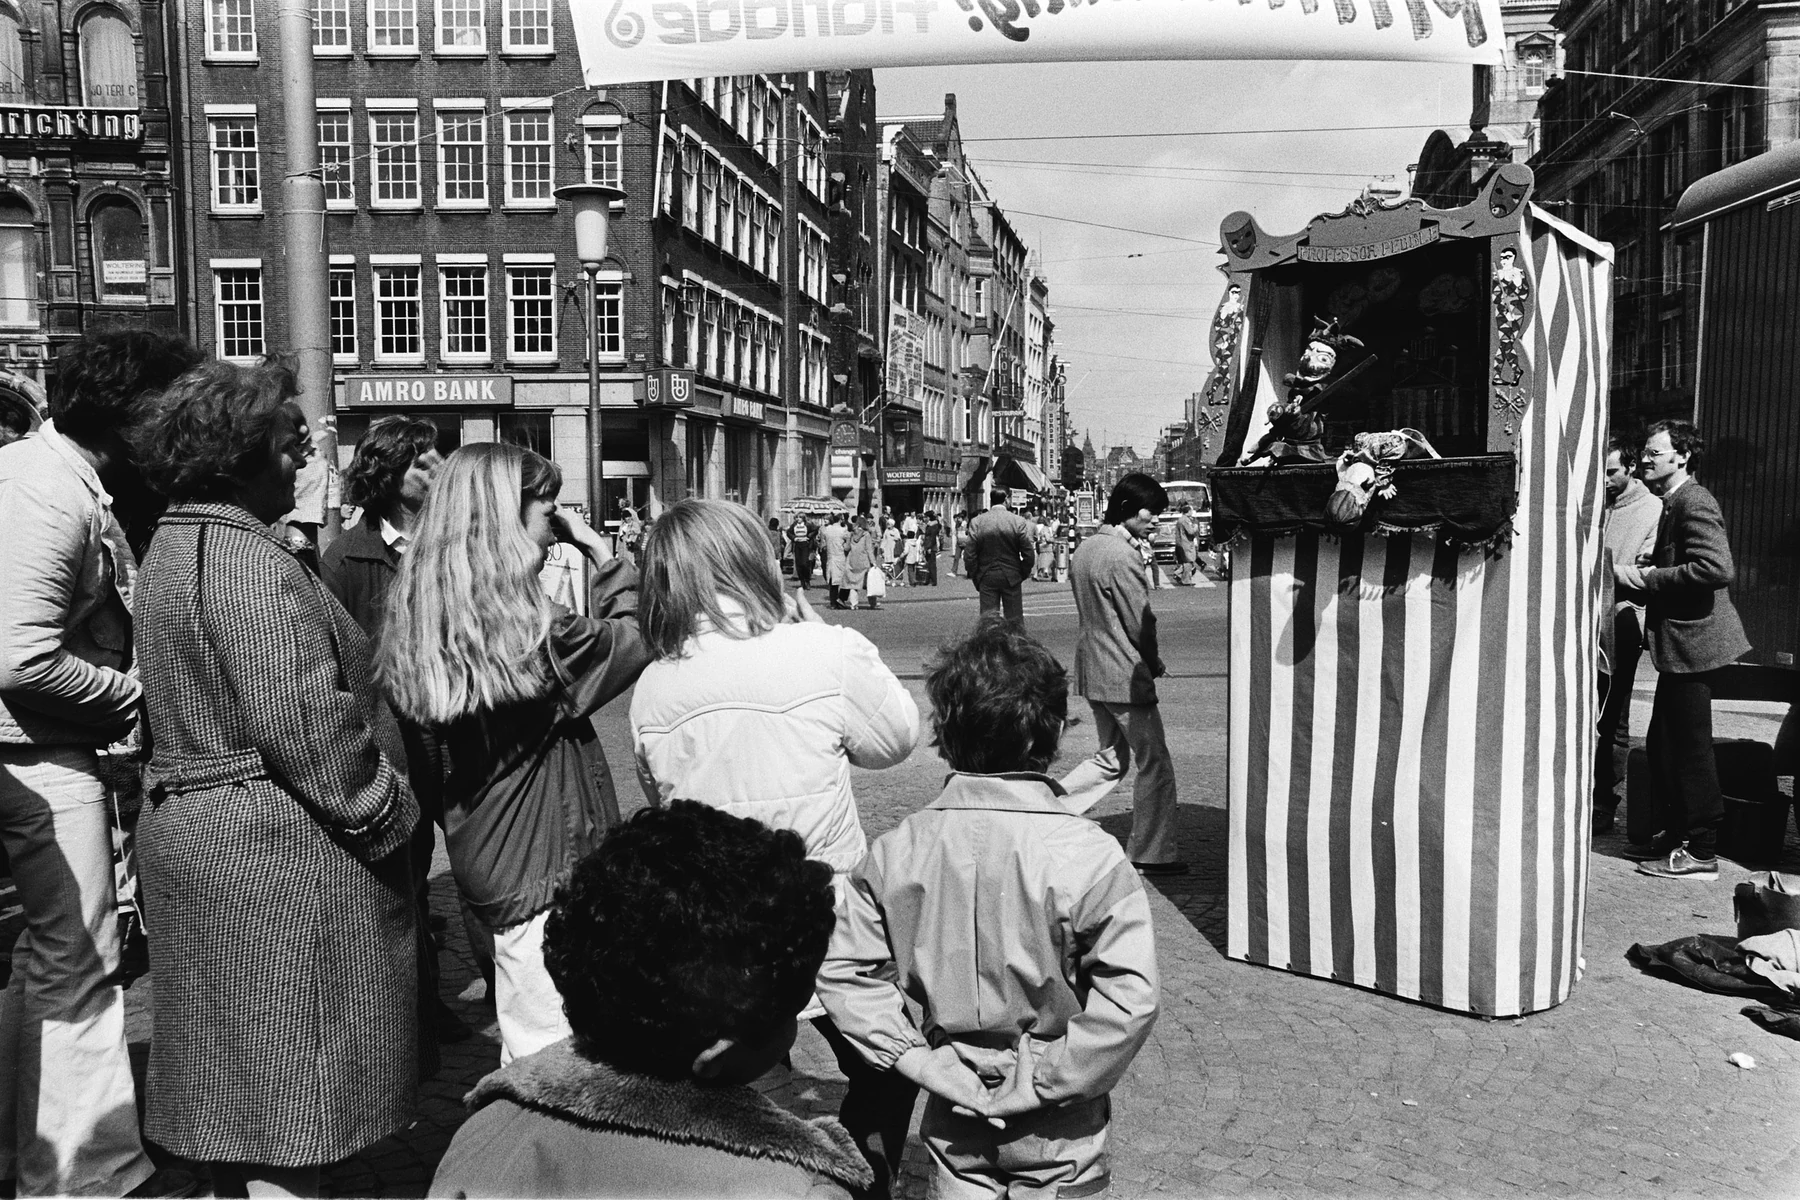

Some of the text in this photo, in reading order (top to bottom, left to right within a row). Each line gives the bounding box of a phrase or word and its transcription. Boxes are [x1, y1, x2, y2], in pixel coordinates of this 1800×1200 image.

[1300, 244, 1378, 262] PROFESSOR
[360, 380, 496, 402] AMRO BANK
